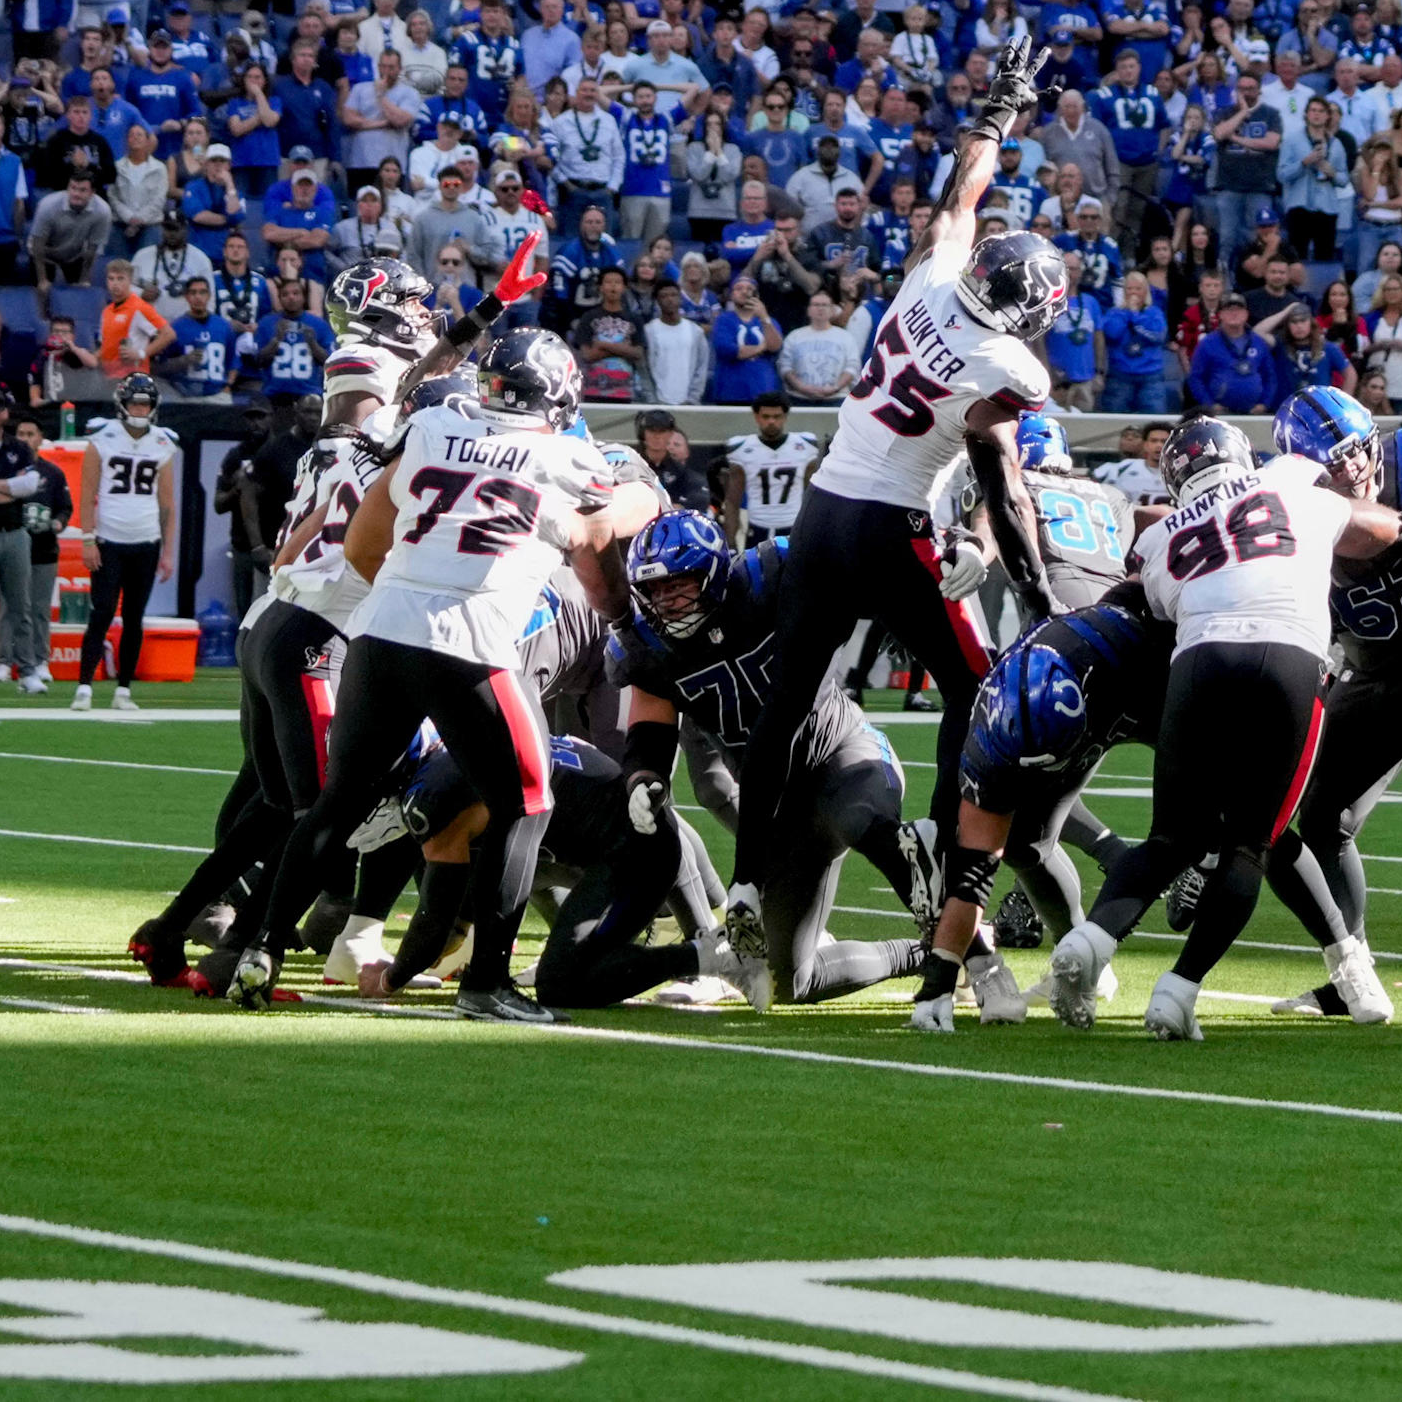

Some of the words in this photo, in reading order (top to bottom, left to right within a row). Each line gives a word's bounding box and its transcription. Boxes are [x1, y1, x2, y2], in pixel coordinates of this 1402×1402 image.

[502, 226, 529, 255] 12
[271, 341, 312, 380] 28
[902, 299, 966, 383] HUNTER
[107, 455, 159, 496] 38
[445, 435, 530, 474] TOGIAI
[756, 466, 797, 505] 17
[1163, 473, 1262, 536] RANKINS
[402, 466, 542, 558] 72
[1038, 489, 1126, 564] 81
[1166, 490, 1298, 582] 98
